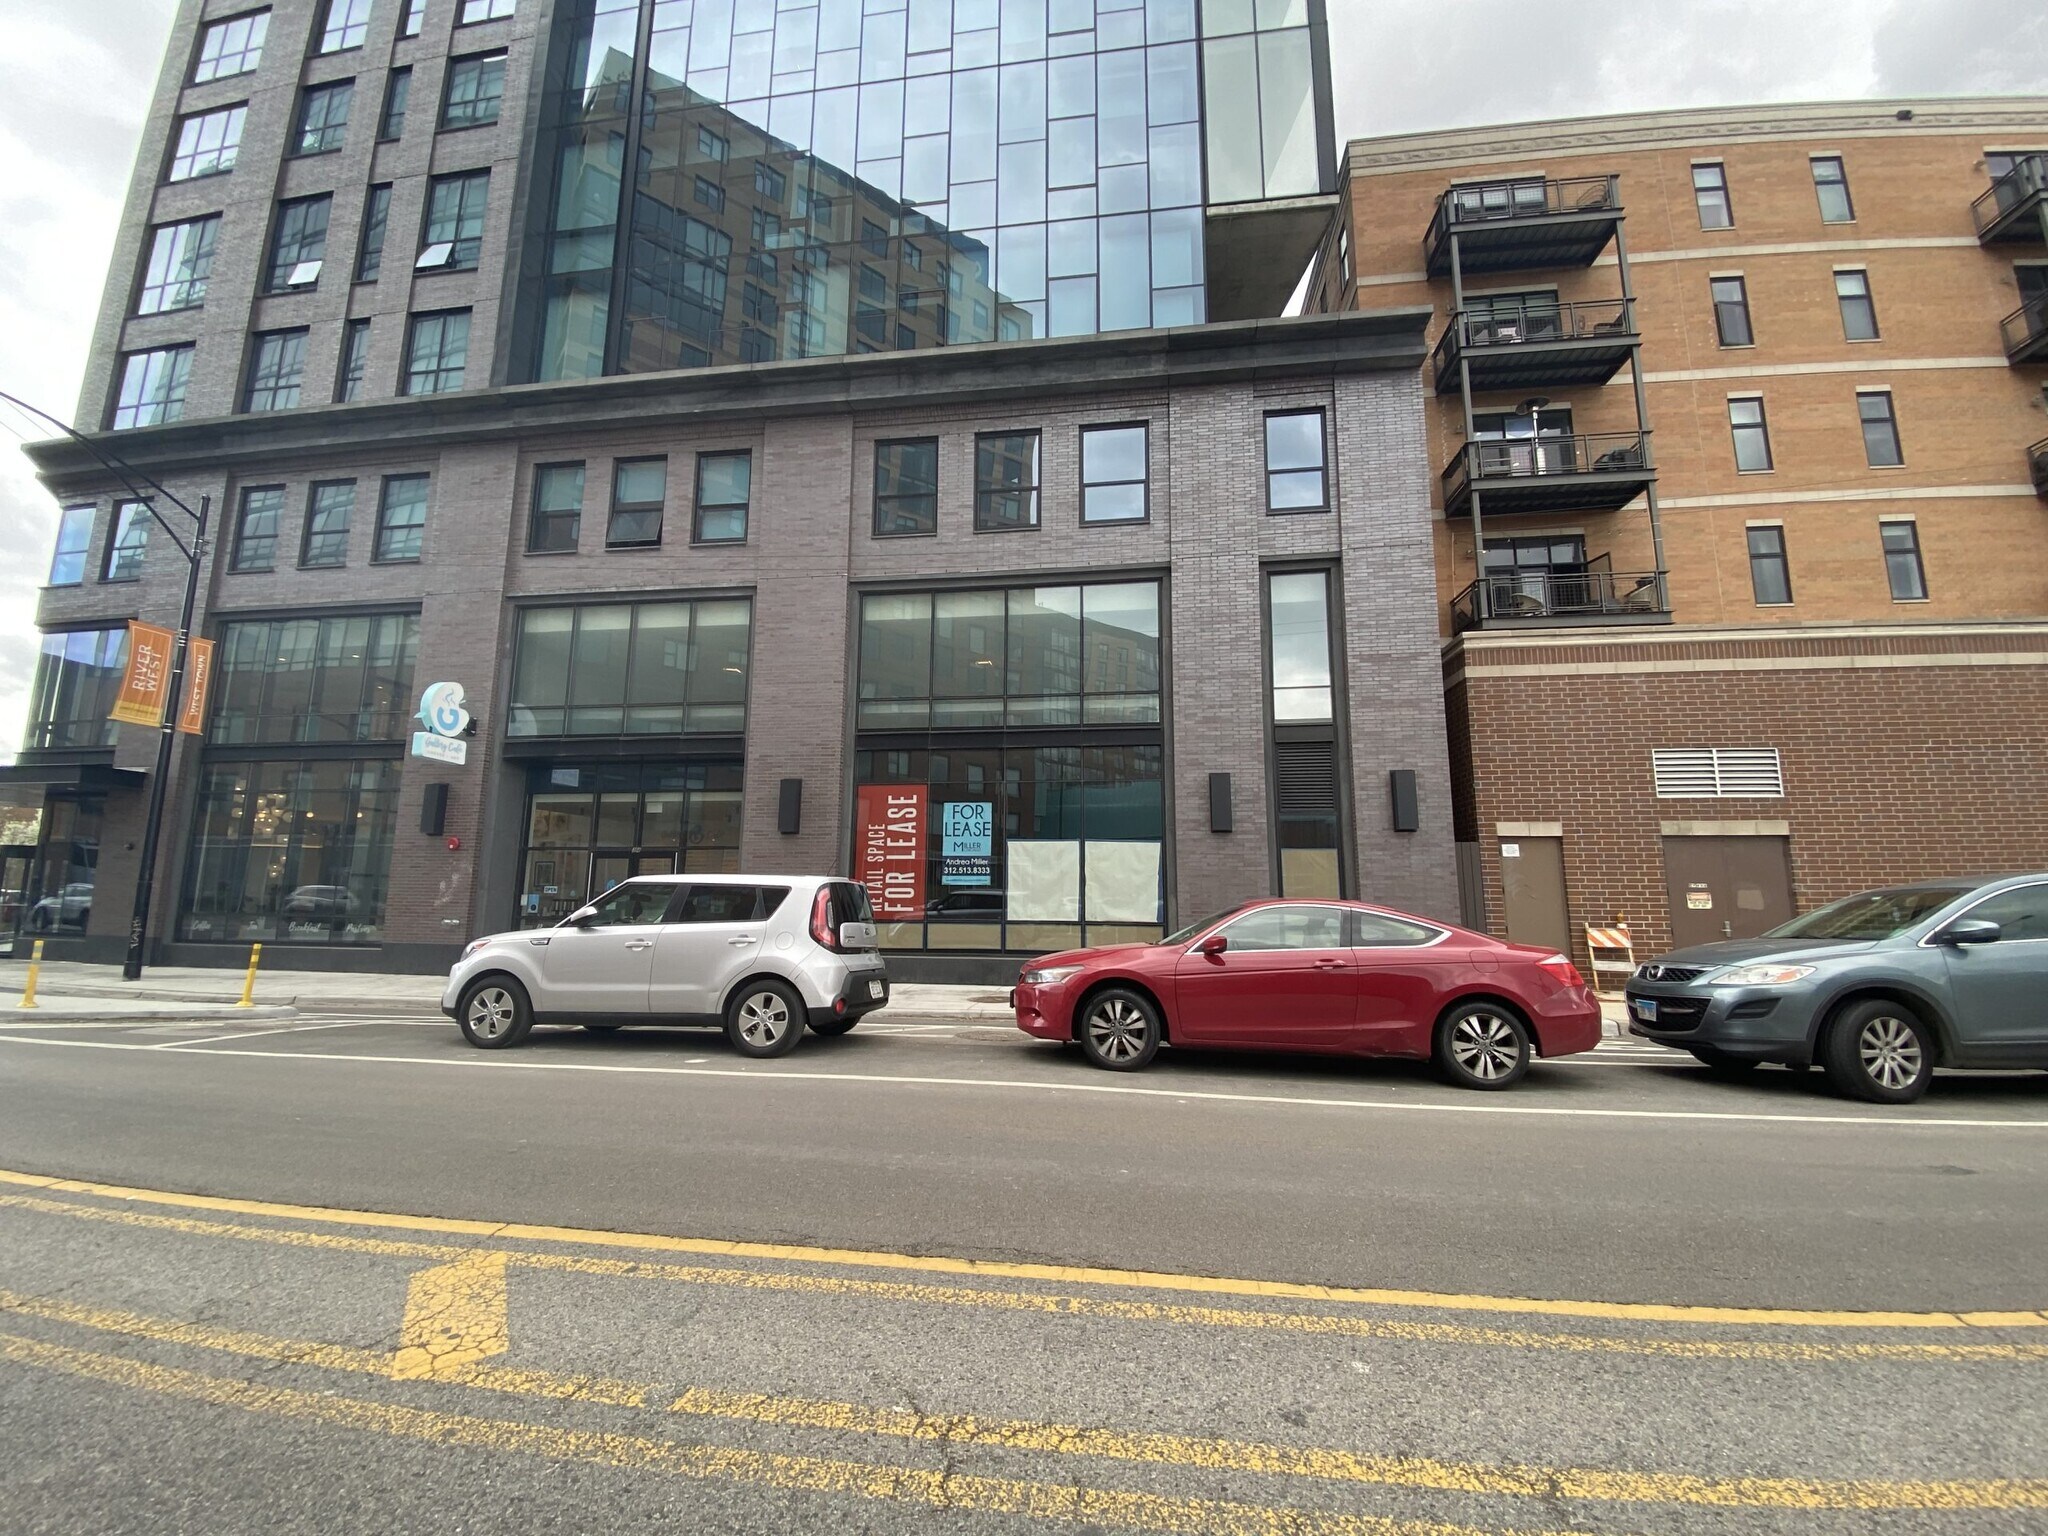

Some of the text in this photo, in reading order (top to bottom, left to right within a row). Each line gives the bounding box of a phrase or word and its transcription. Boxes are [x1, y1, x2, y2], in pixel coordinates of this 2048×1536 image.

[132, 644, 152, 691] RIVER
[146, 652, 162, 691] WEST
[189, 654, 206, 716] WEST TOWN
[945, 821, 991, 837] LEASE
[952, 804, 984, 820] FOR
[867, 823, 885, 862] SPACE
[884, 795, 917, 912] FOR LEASE
[945, 858, 970, 866] Andrea
[943, 866, 990, 874] 312.513.8333
